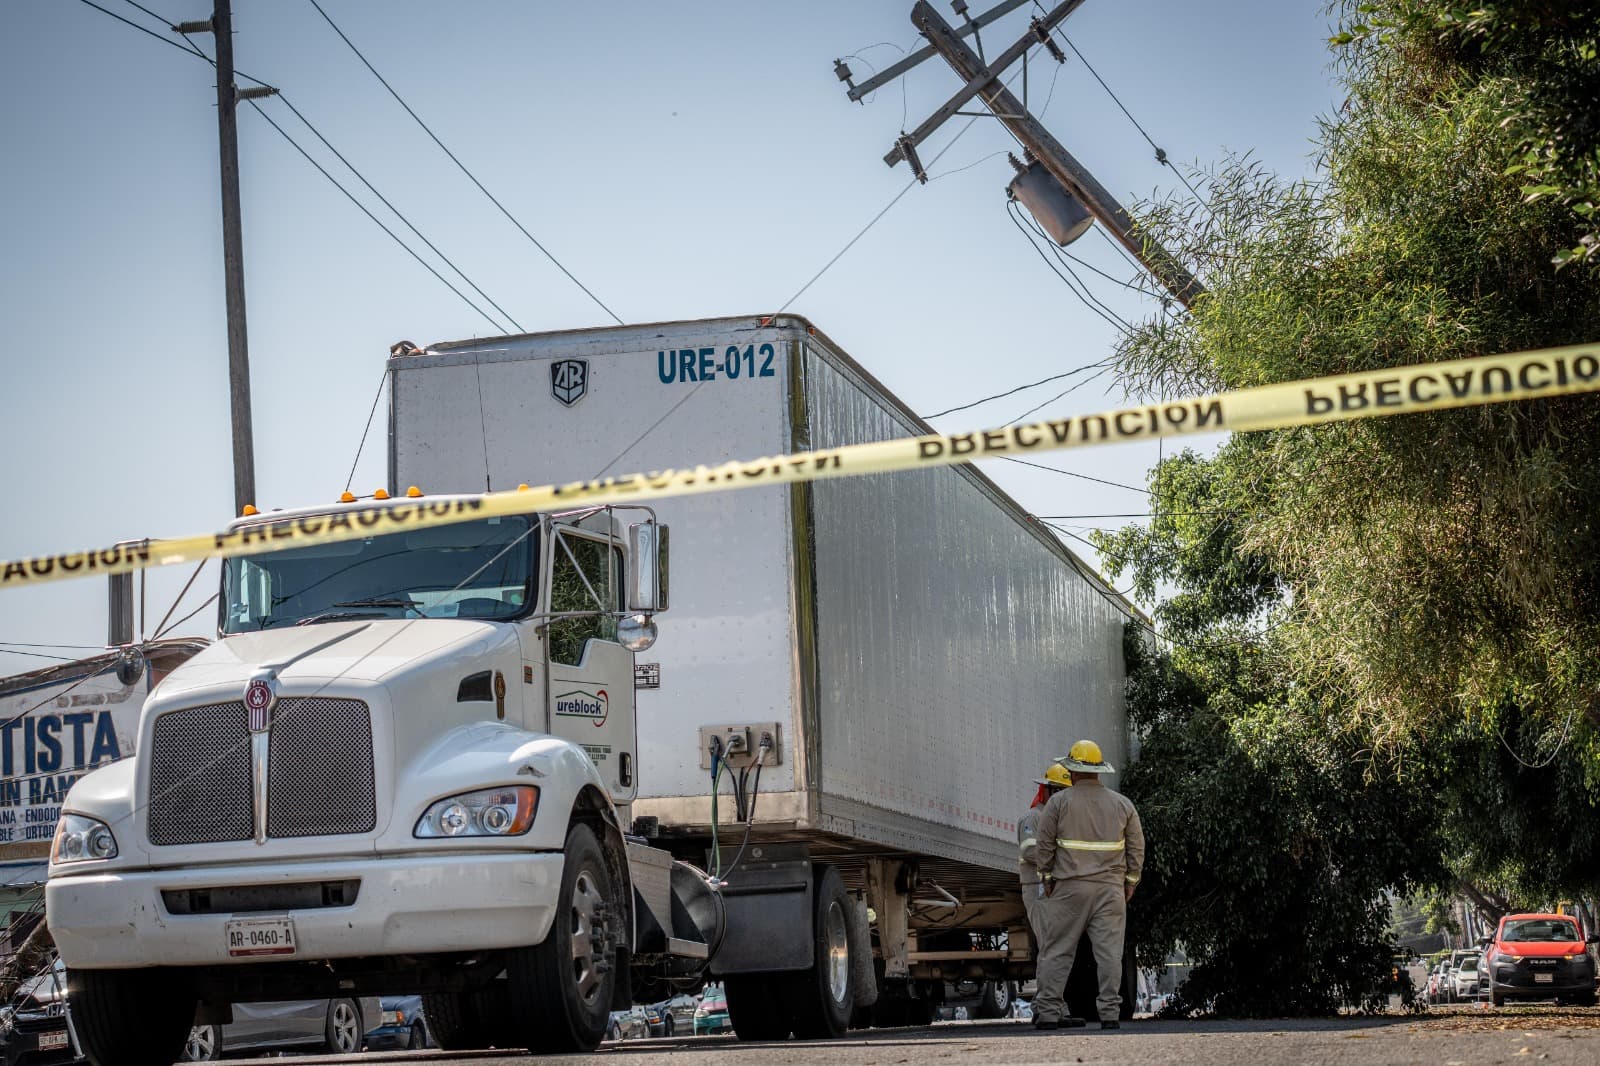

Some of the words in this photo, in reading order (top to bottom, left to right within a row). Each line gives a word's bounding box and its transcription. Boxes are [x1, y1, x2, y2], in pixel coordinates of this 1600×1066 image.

[657, 343, 775, 384] URE-012
[557, 699, 602, 715] ureblock
[0, 710, 121, 776] TISTA
[29, 774, 85, 805] RAM
[26, 823, 57, 840] ORTOD
[230, 928, 292, 946] AR-0460-A
